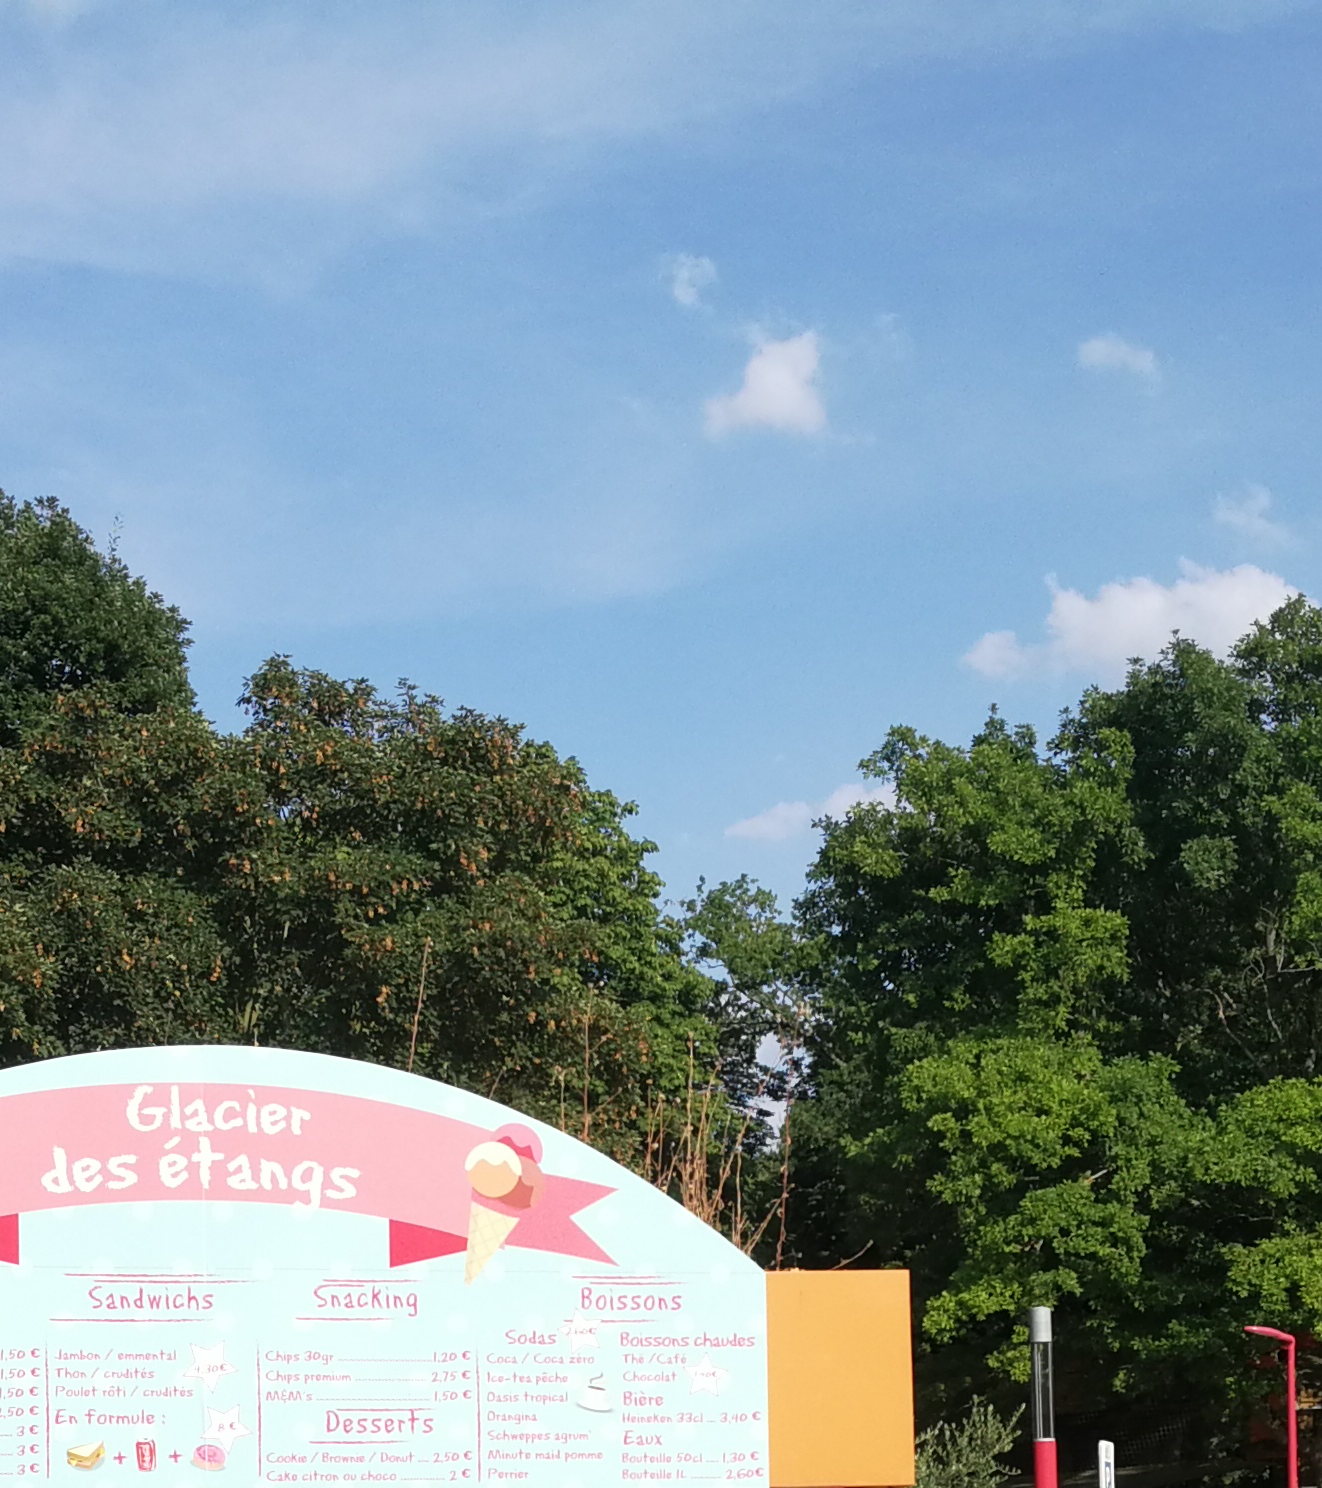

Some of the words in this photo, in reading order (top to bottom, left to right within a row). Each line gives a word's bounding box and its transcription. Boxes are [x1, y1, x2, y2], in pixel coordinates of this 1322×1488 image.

[126, 1085, 311, 1135] Glacier
[41, 1144, 139, 1194] des
[158, 1136, 362, 1211] étangs
[88, 1285, 214, 1310] Sandwichs
[314, 1284, 418, 1317] Snacking
[581, 1287, 682, 1311] Boissons
[505, 1329, 559, 1345] Sodas
[620, 1332, 689, 1347] Boissons
[694, 1332, 755, 1347] chaudes
[55, 1349, 100, 1360] Jambon
[118, 1350, 176, 1360] emmental
[265, 1351, 299, 1364] Chips
[304, 1351, 333, 1365] 30gr
[487, 1353, 517, 1364] Coca
[534, 1353, 564, 1364] Coca
[623, 1354, 644, 1364] Thé
[55, 1368, 86, 1378] Thon
[104, 1368, 154, 1379] crudités
[266, 1370, 300, 1384] Chips
[304, 1374, 351, 1384] premium
[487, 1371, 532, 1383] Ice-tea
[536, 1372, 568, 1385] pêche
[623, 1371, 677, 1382] Chocolat
[55, 1386, 97, 1397] Poulet
[103, 1386, 126, 1397] rôti
[143, 1386, 193, 1397] crudités
[487, 1392, 519, 1402] Oasis
[523, 1391, 568, 1405] tropical
[623, 1391, 663, 1406] Bière
[55, 1409, 77, 1424] En
[85, 1409, 155, 1424] formule
[326, 1409, 434, 1434] Desserts
[487, 1411, 537, 1424] Orangina
[622, 1413, 672, 1423] Heineken
[487, 1429, 550, 1443] Schweppes
[624, 1430, 662, 1446] Eaux
[266, 1453, 307, 1463] Cookie
[322, 1452, 365, 1463] Brownie
[381, 1451, 414, 1463] Donut
[488, 1449, 531, 1460] Minute
[535, 1449, 560, 1460] maid
[565, 1452, 603, 1462] pomme
[622, 1452, 671, 1463] Bouteille
[267, 1471, 297, 1481] Cake
[302, 1470, 339, 1481] citron
[361, 1470, 396, 1481] choco
[488, 1468, 529, 1479] Perrier
[622, 1469, 672, 1479] Bouteille
